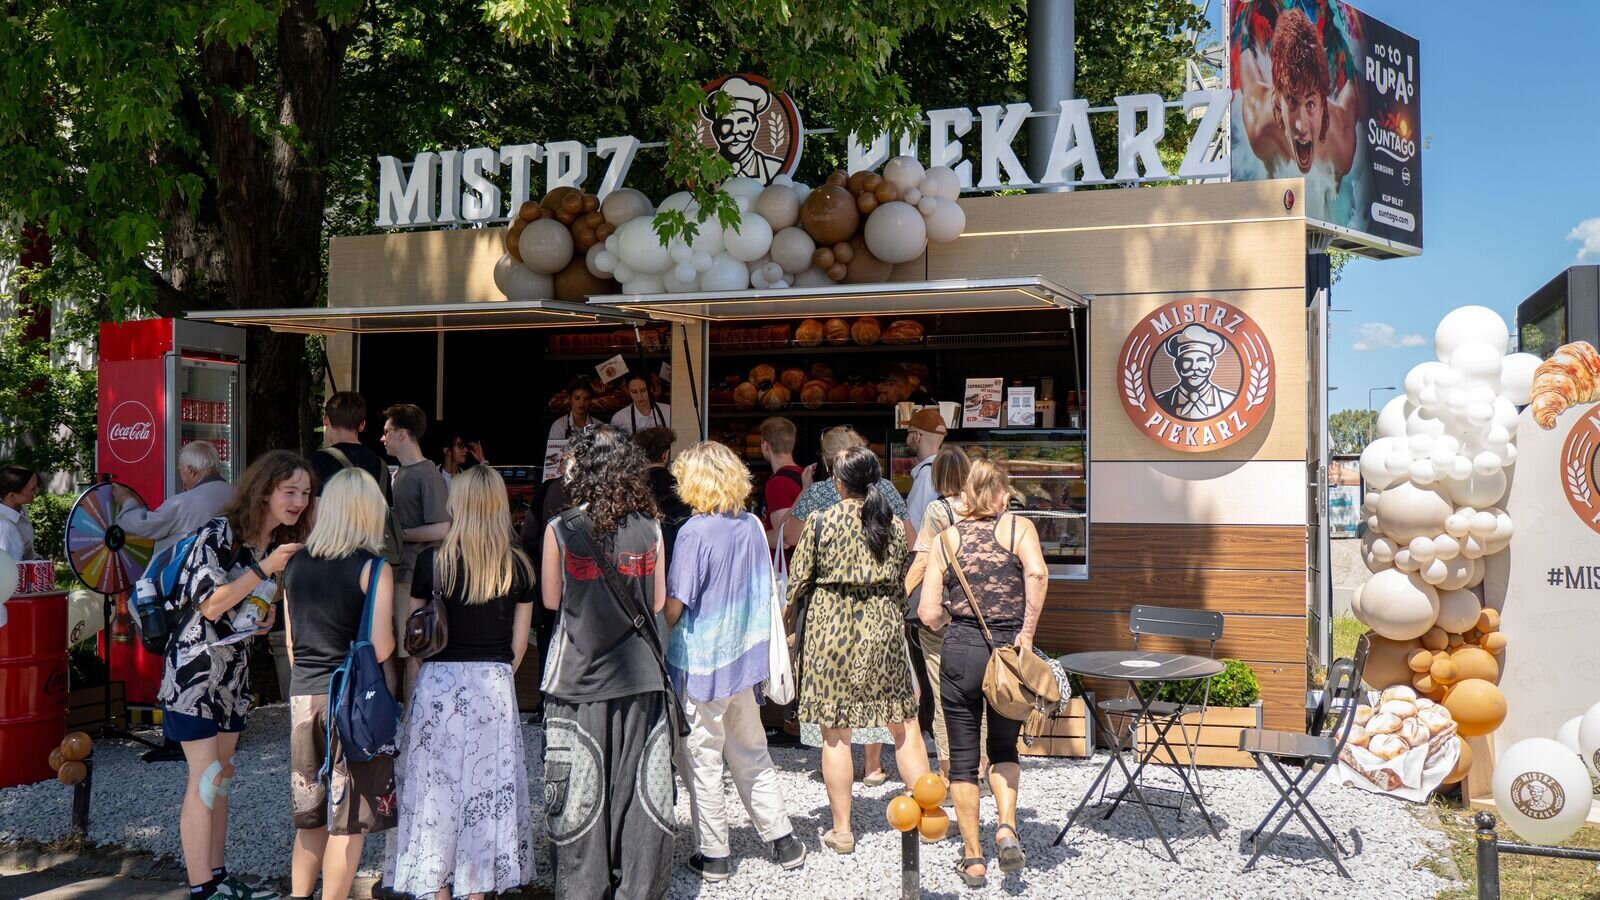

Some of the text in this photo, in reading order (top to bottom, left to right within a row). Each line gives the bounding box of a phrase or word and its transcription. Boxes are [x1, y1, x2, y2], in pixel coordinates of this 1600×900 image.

[1374, 43, 1402, 66] no to
[1368, 118, 1415, 158] SUNTAGO
[1373, 162, 1394, 176] SAMSUNG
[376, 135, 640, 226] MISTRZ
[1381, 193, 1404, 208] KUP BILET
[1378, 209, 1409, 224] suntago.com
[1149, 303, 1246, 336] MISTRZ
[110, 422, 153, 440] Coca-Cola
[1144, 411, 1248, 447] PIEKARZ
[1520, 772, 1556, 786] MISTRZ
[1519, 804, 1556, 819] PIEKARZ
